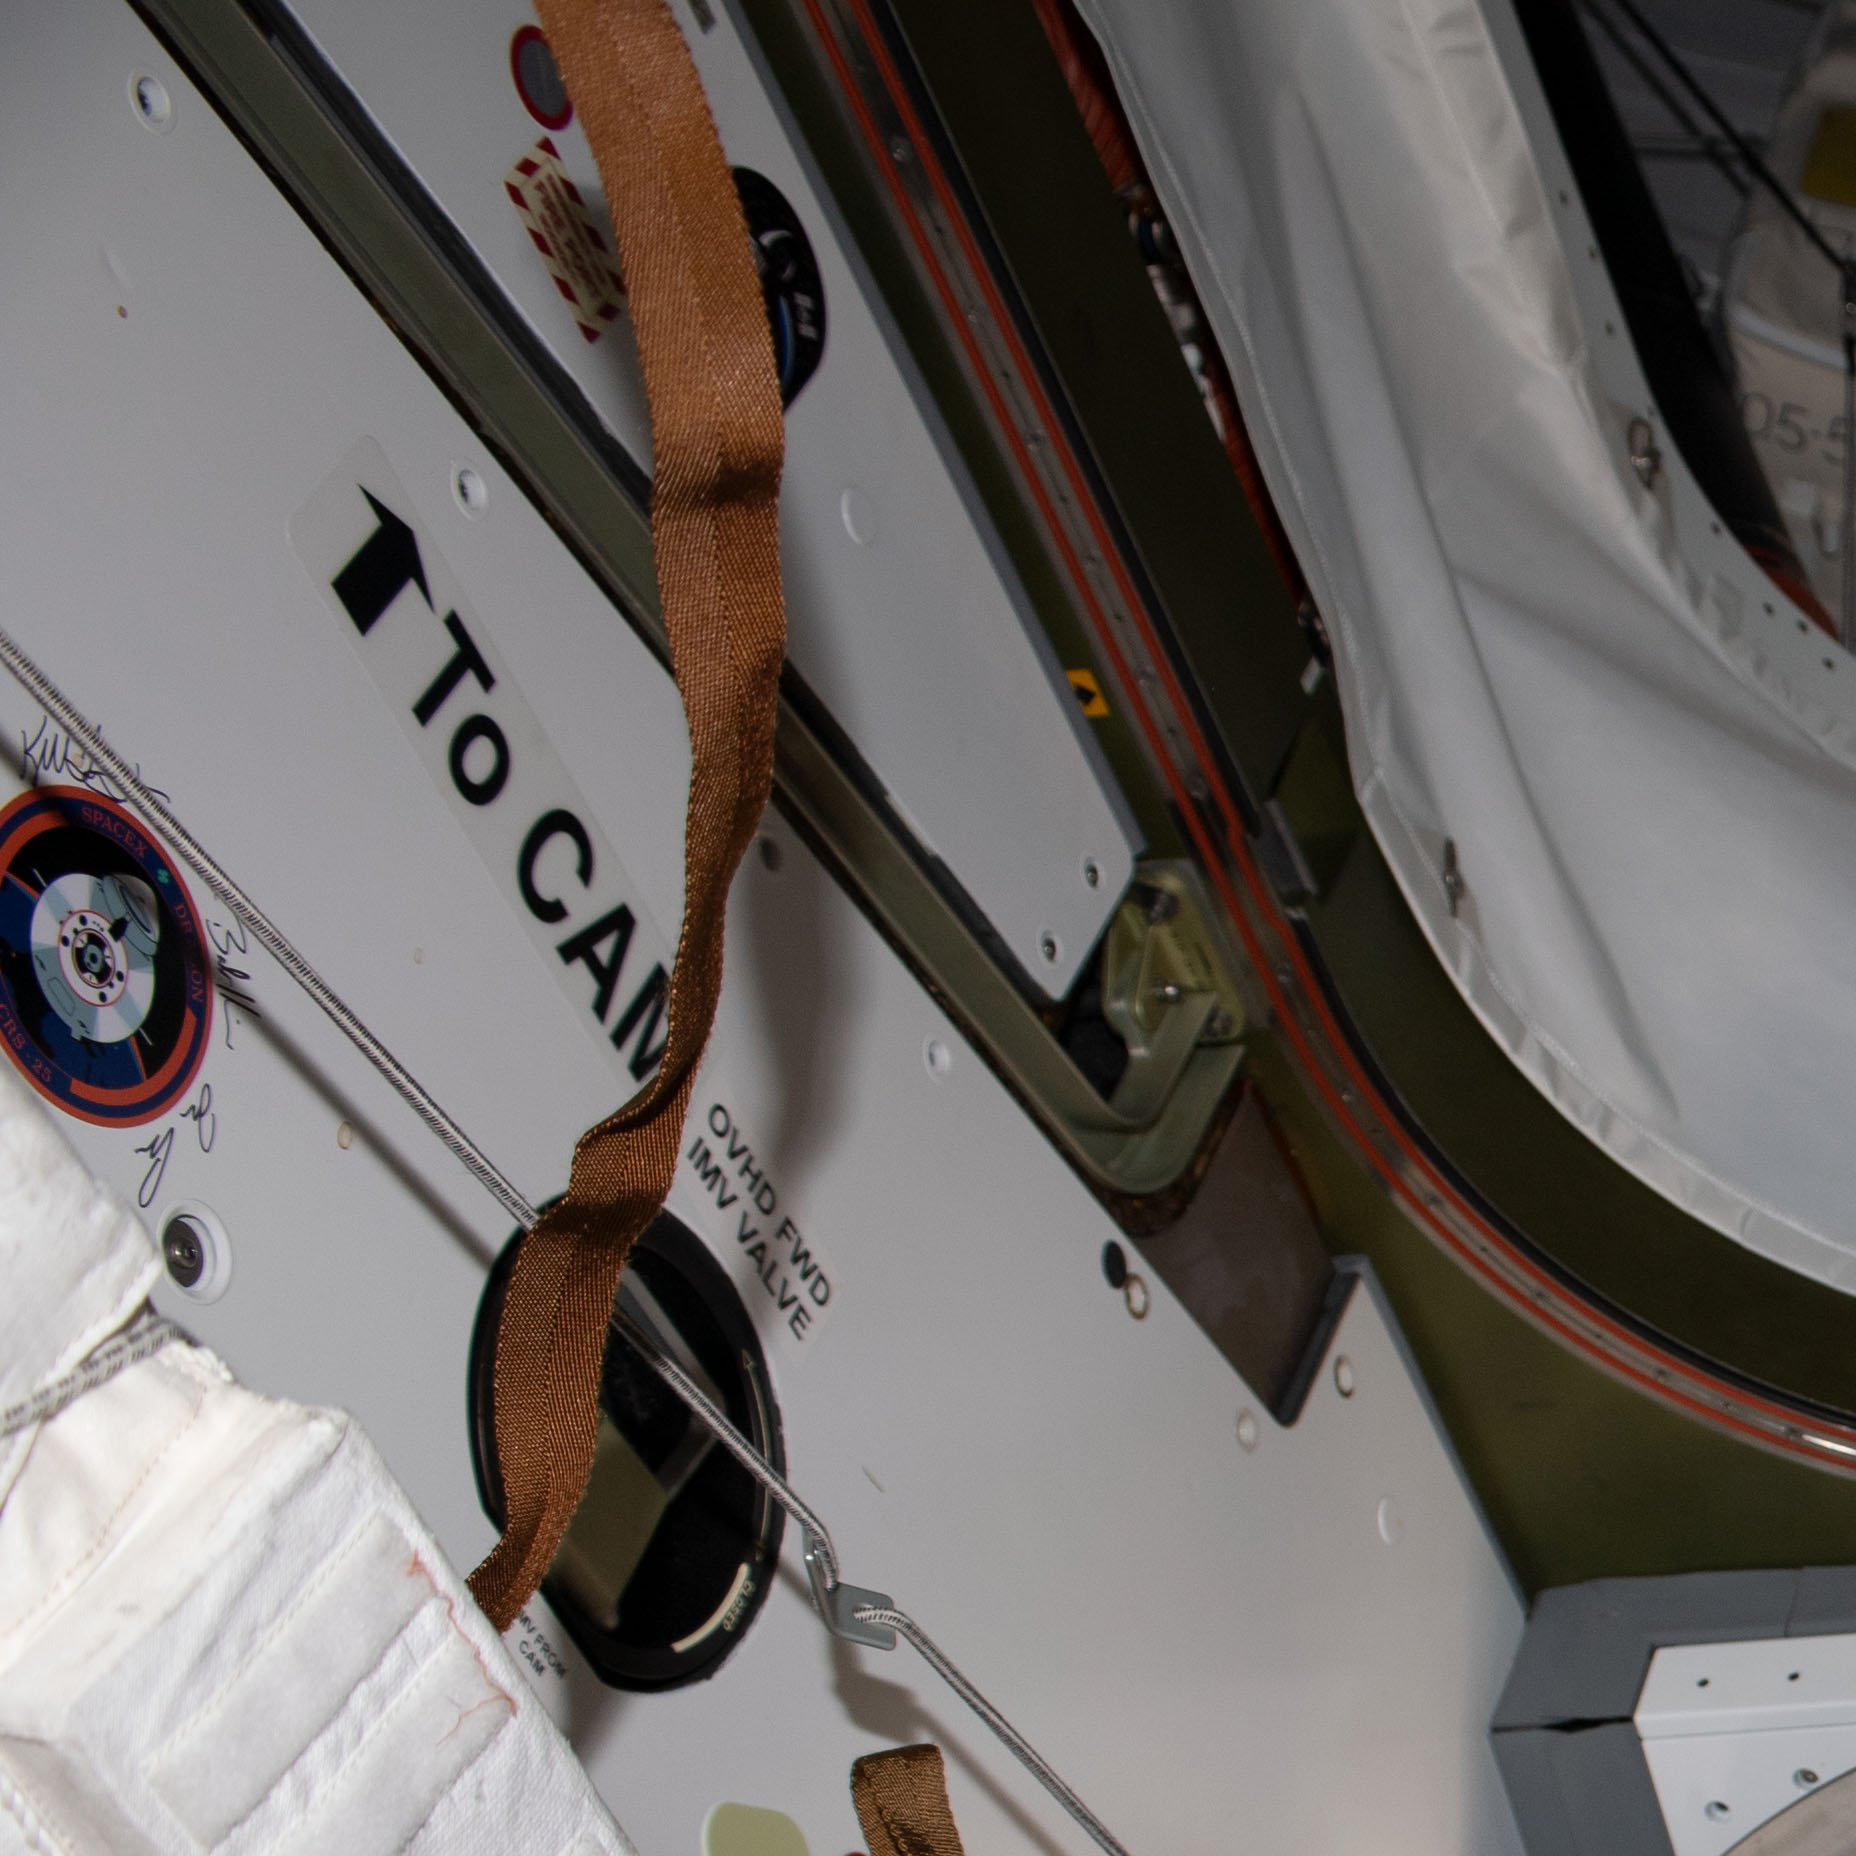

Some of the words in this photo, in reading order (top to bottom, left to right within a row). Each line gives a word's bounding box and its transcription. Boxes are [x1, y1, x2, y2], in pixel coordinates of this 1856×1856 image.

[412, 608, 512, 807] TO
[81, 806, 147, 859] SPACEX
[687, 1138, 739, 1212] IMV
[736, 1213, 813, 1342] VALVE
[705, 1102, 779, 1218] OVHD
[775, 1220, 832, 1310] FWD
[518, 1638, 545, 1679] CAM
[534, 1630, 568, 1680] FROM
